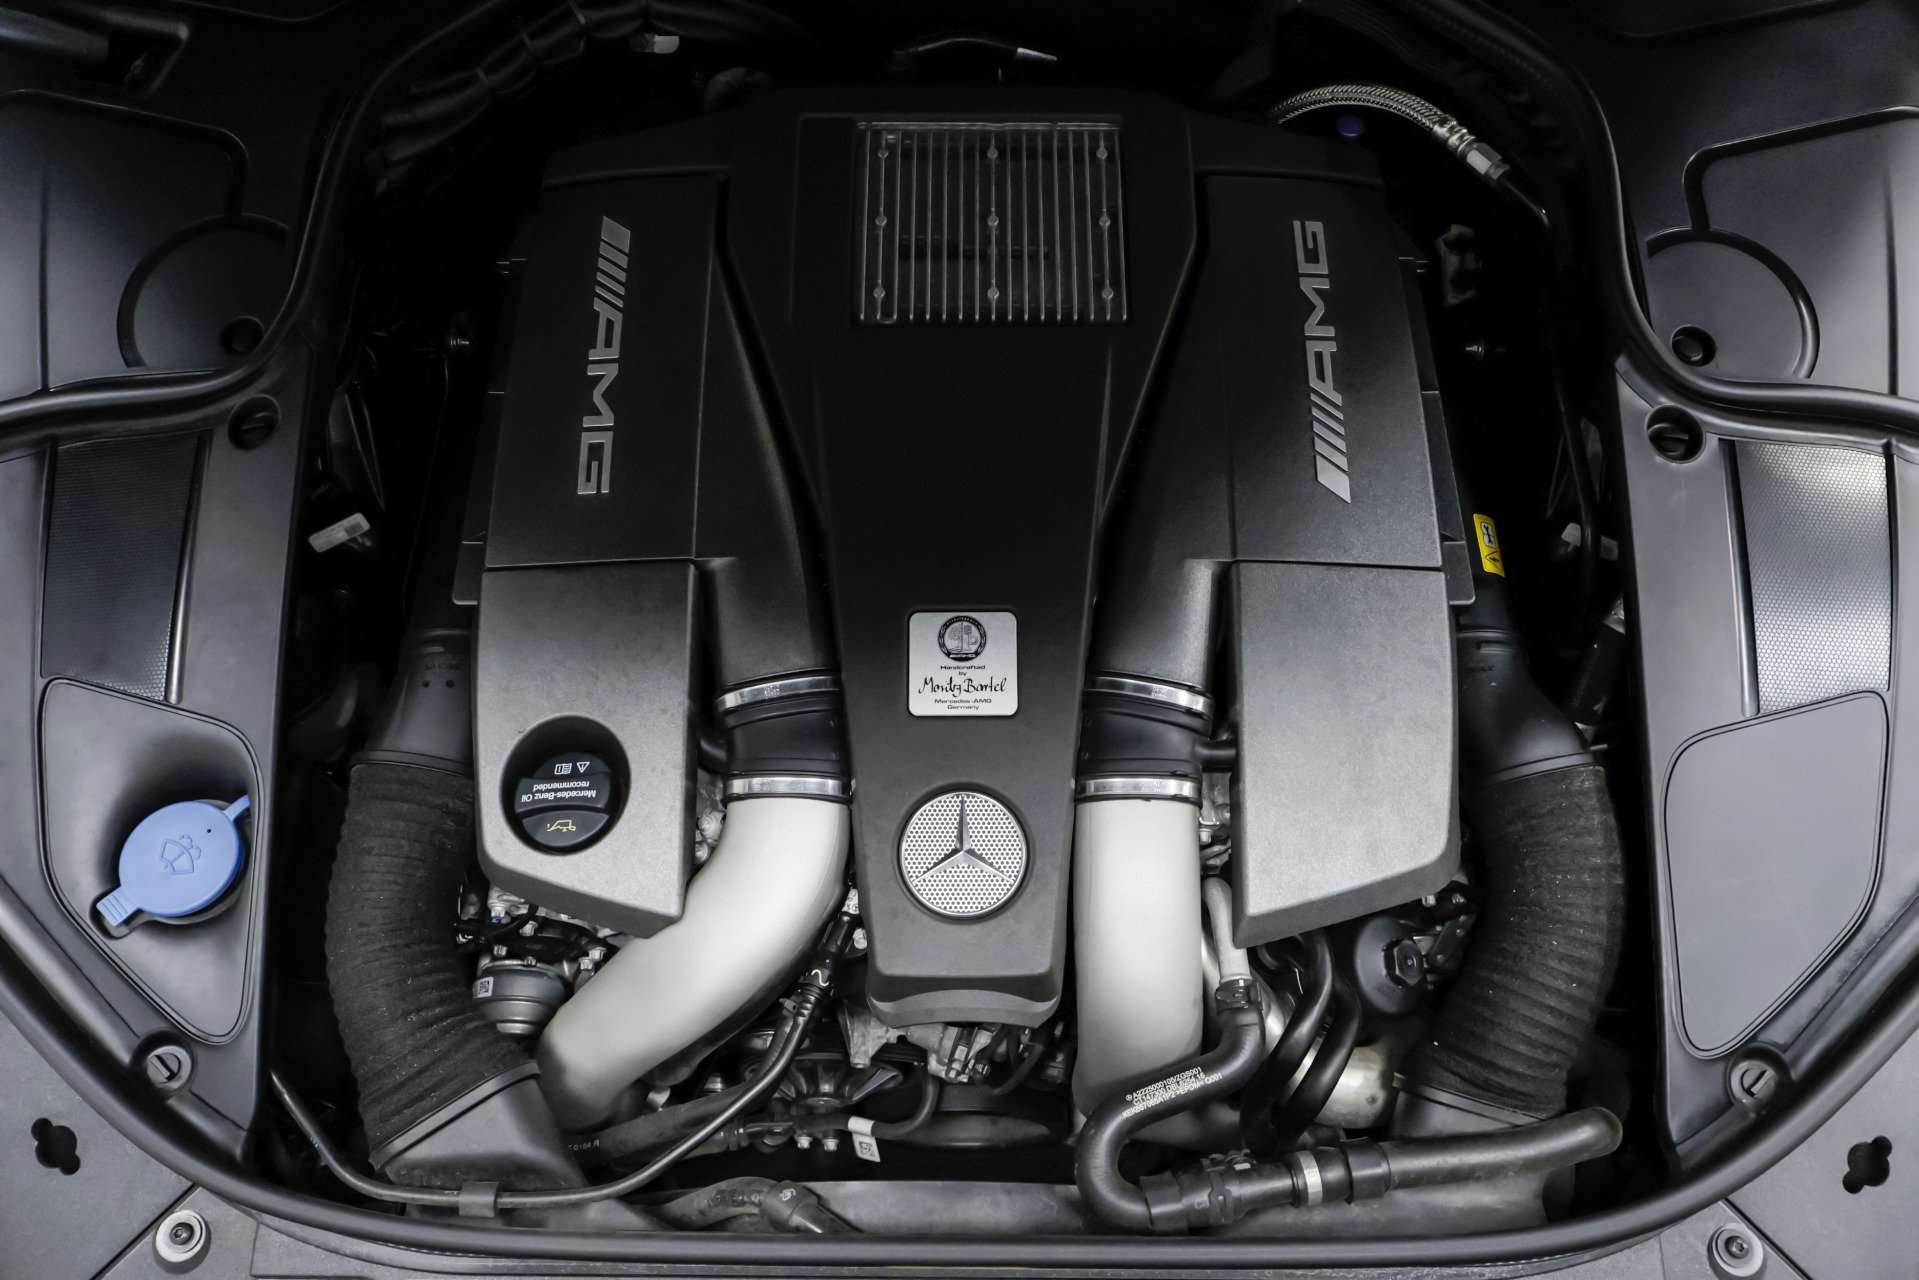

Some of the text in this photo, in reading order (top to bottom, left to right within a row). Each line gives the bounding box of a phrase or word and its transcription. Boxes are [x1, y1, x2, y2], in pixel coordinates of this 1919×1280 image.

[918, 676, 1007, 697] Moritz Bartel
[533, 781, 590, 792] recommended
[521, 790, 596, 802] Mercedes-Benz Oil
